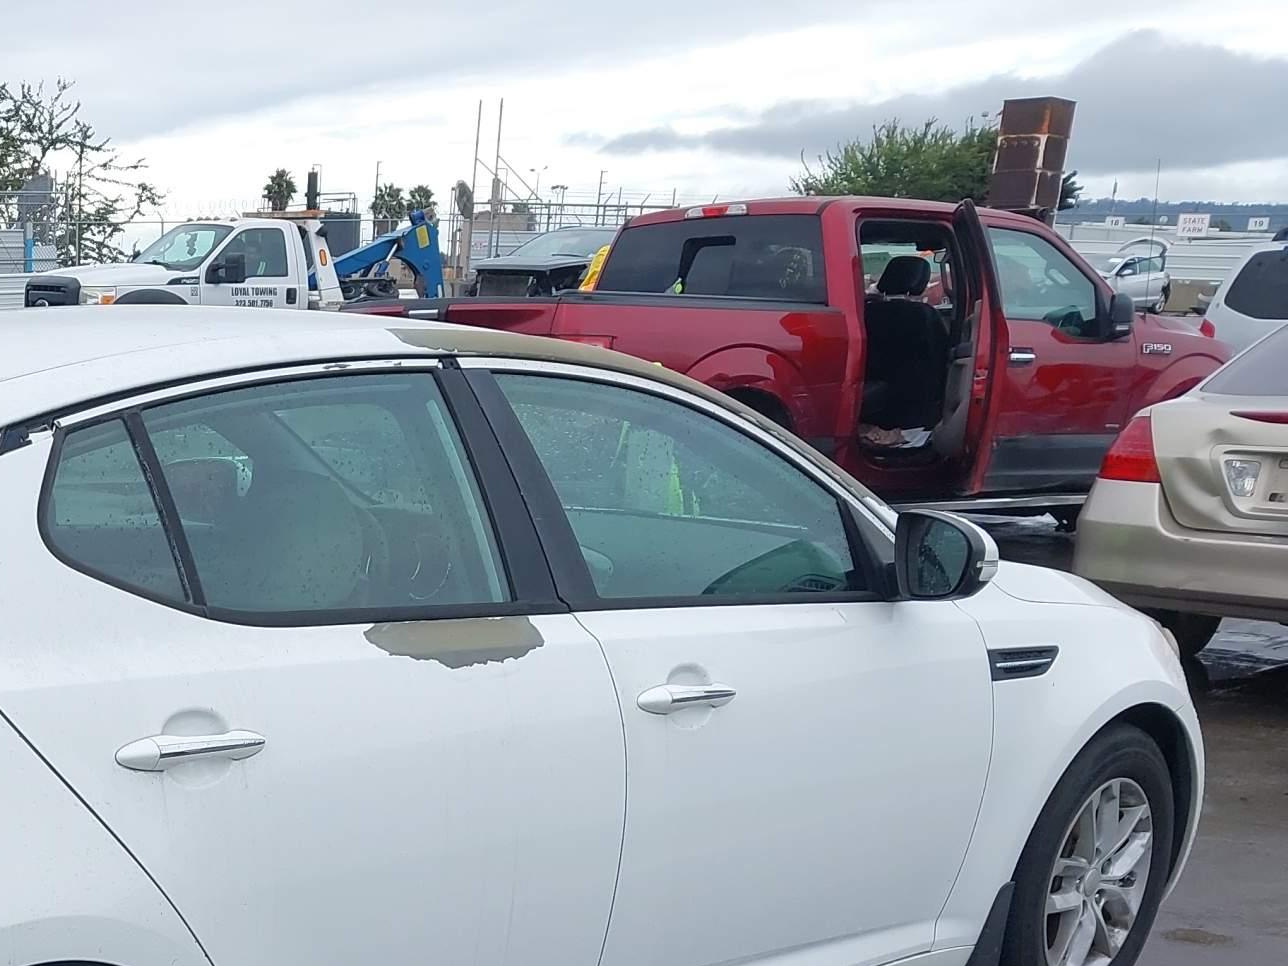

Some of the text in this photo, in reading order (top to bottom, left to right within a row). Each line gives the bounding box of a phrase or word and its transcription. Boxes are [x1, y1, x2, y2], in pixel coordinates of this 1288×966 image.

[1183, 217, 1208, 225] STATE
[1254, 220, 1264, 228] 19
[231, 287, 278, 296] LOYAL TOWING
